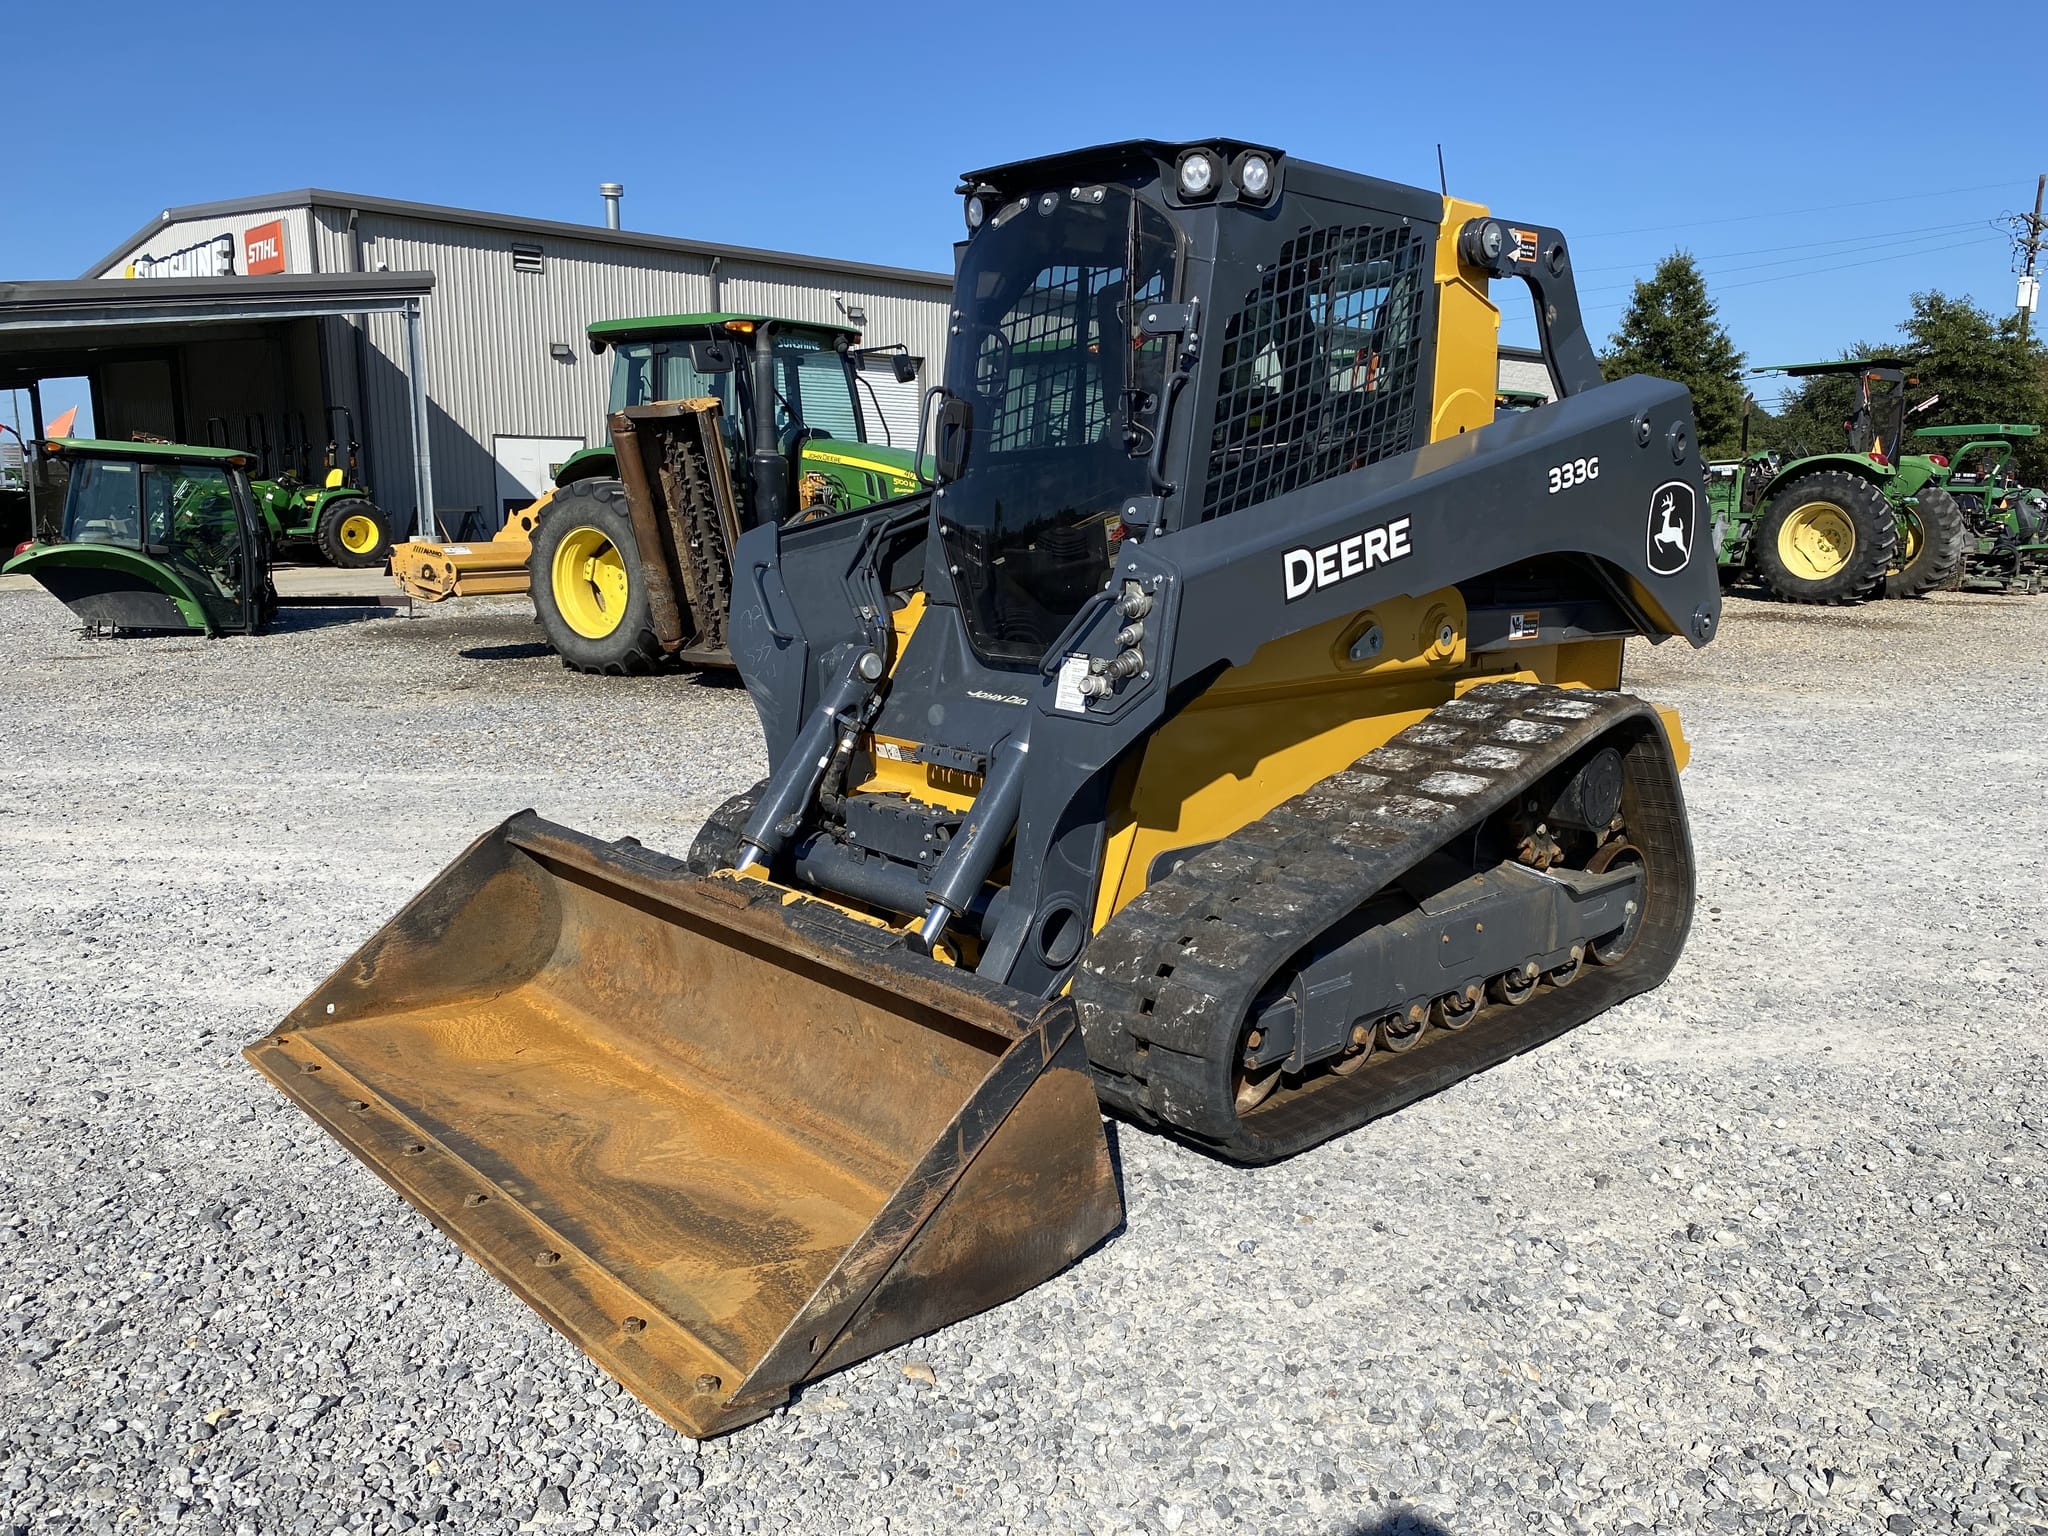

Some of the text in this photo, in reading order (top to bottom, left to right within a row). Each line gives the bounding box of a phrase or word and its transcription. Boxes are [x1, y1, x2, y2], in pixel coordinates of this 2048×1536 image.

[248, 237, 278, 264] STIHL
[778, 336, 820, 350] SUNSHINE
[808, 453, 841, 464] JOHN DEERE
[1549, 456, 1599, 494] 333G
[1283, 517, 1412, 600] DEERE
[967, 690, 1007, 702] JOHN
